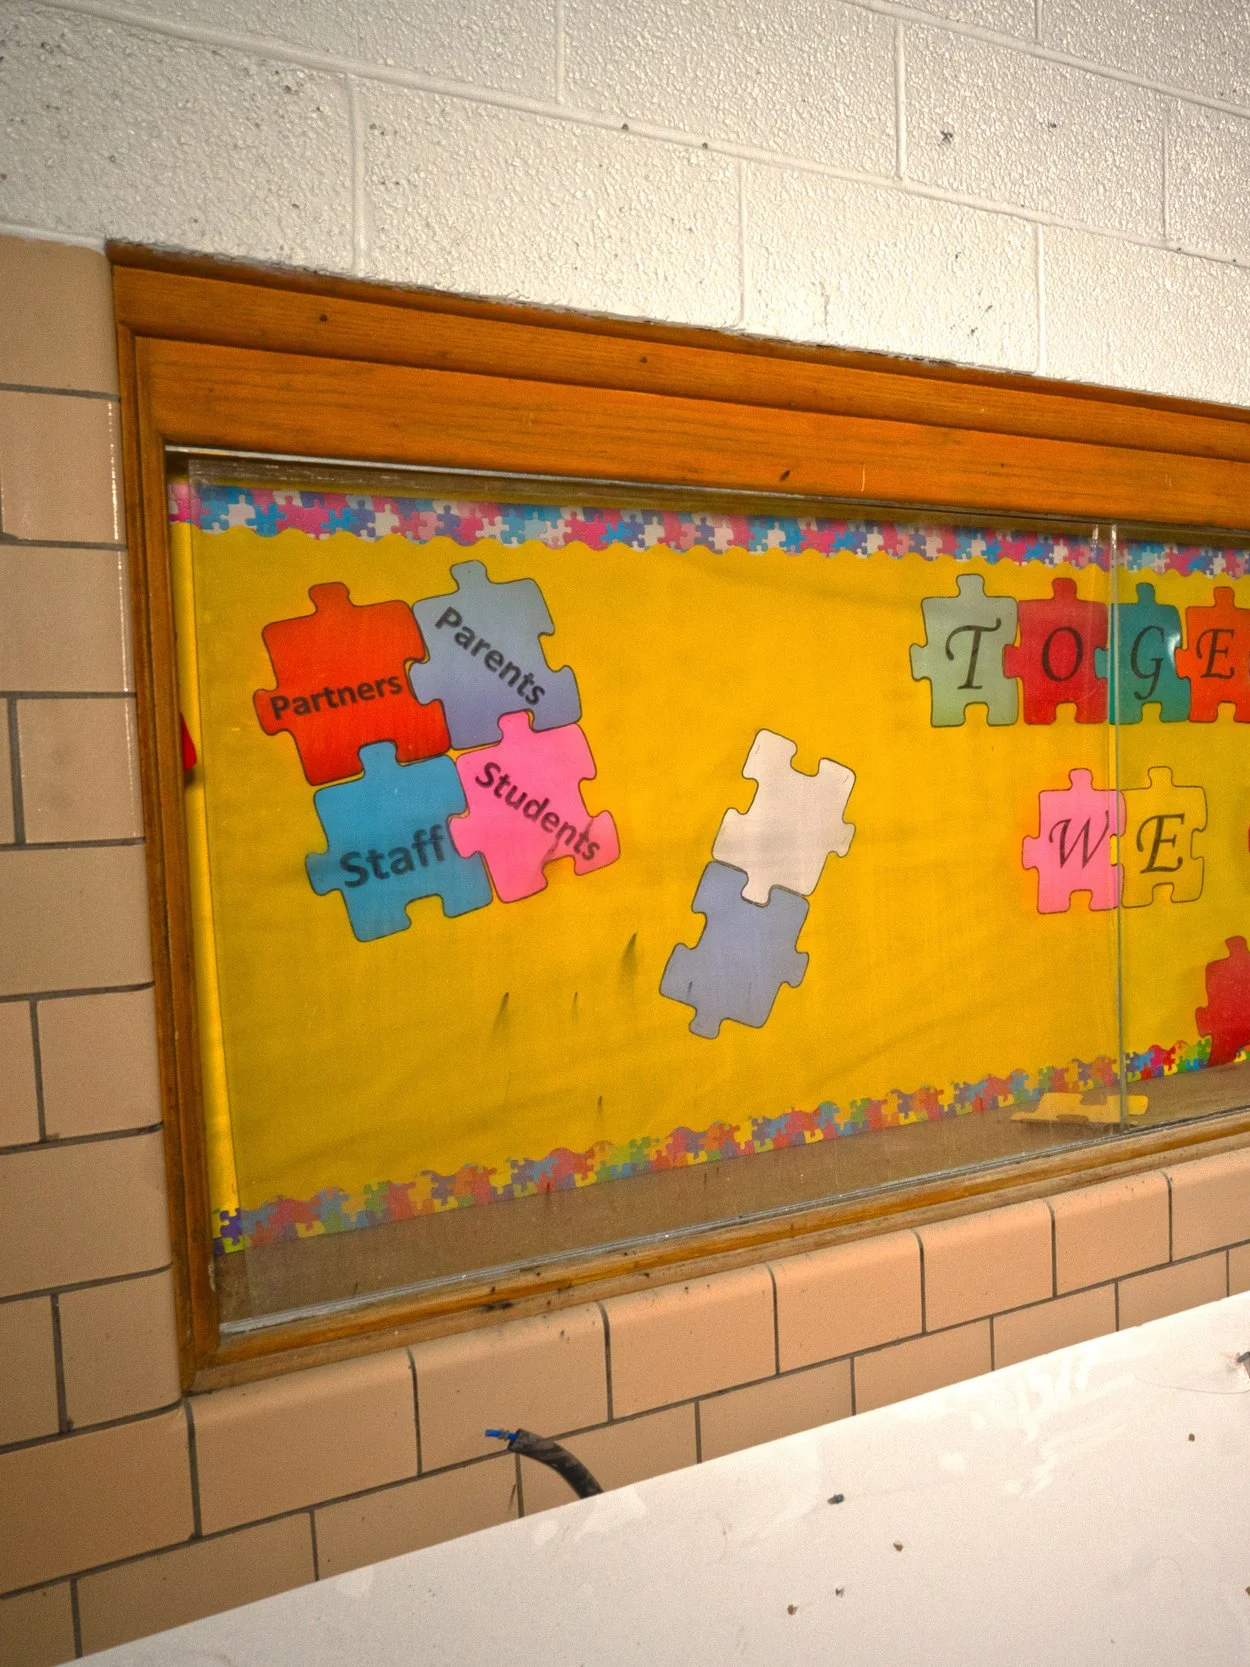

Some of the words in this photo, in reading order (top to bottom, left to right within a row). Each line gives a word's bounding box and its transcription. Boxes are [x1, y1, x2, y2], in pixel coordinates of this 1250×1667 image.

[434, 606, 546, 705] Parents
[270, 674, 403, 720] Partners
[474, 761, 601, 861] Students
[1048, 810, 1186, 874] WE
[338, 823, 447, 888] Staff
